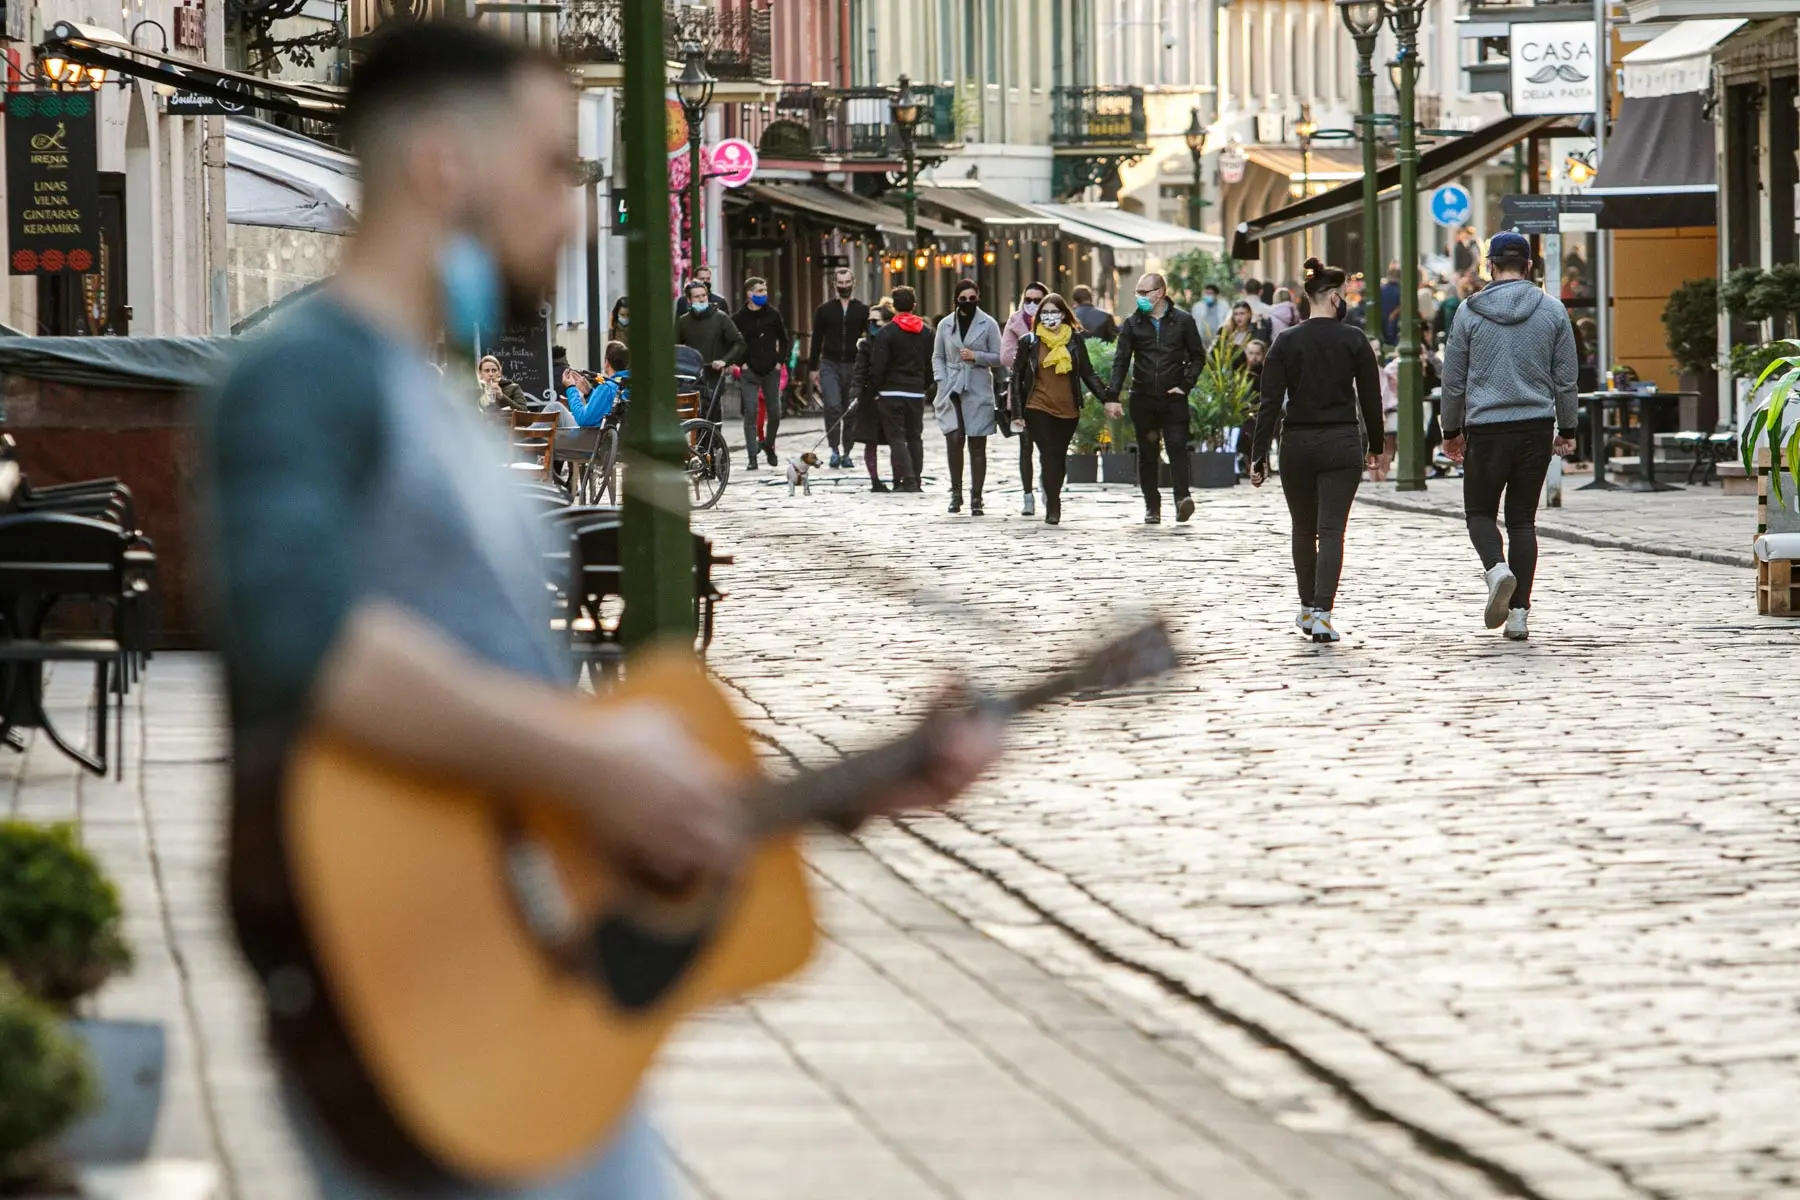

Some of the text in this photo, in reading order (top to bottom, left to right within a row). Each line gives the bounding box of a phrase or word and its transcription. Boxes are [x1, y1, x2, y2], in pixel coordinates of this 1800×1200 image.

[1521, 41, 1592, 62] CASA
[1522, 88, 1592, 100] DELLA PASTA
[171, 92, 214, 107] Boutique
[30, 154, 69, 163] IRENA
[34, 181, 68, 191] LINAS
[34, 196, 69, 205] VILNA
[23, 210, 80, 220] GINTARAS
[24, 224, 81, 233] KERAMIKA
